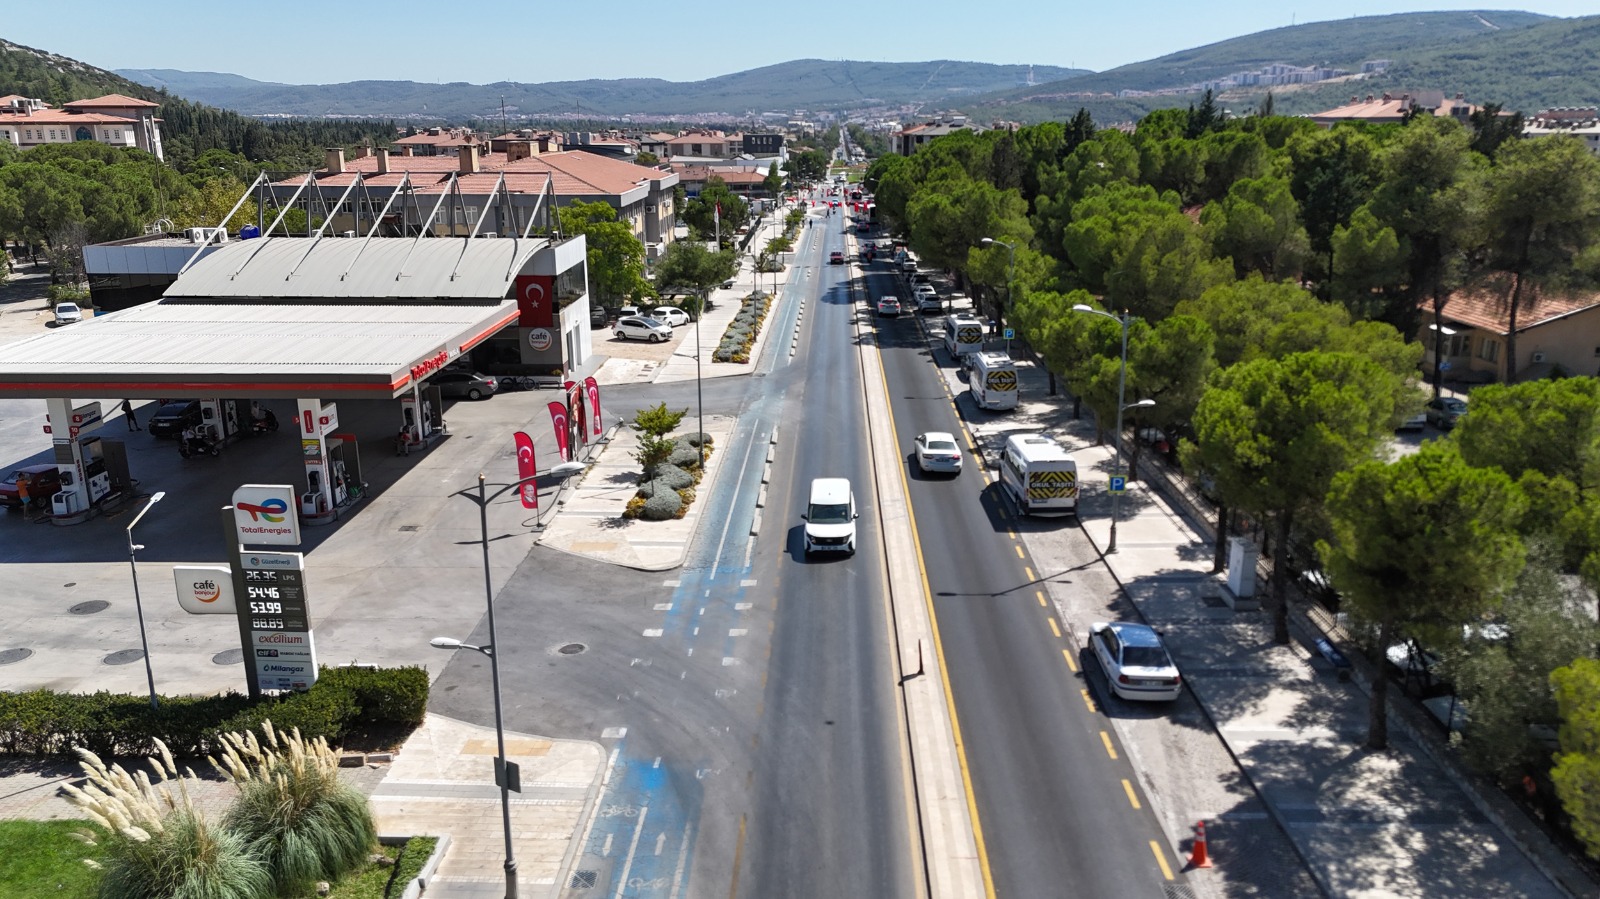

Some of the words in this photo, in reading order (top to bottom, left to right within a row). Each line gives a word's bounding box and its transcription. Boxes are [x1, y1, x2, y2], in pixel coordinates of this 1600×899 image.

[531, 332, 548, 340] café
[1112, 478, 1123, 491] P
[240, 526, 292, 536] TotalEnergies
[193, 579, 215, 590] café
[247, 586, 280, 599] 54.46
[250, 601, 282, 614] 53.99
[258, 634, 303, 644] excellium
[270, 665, 305, 674] Milangaz
